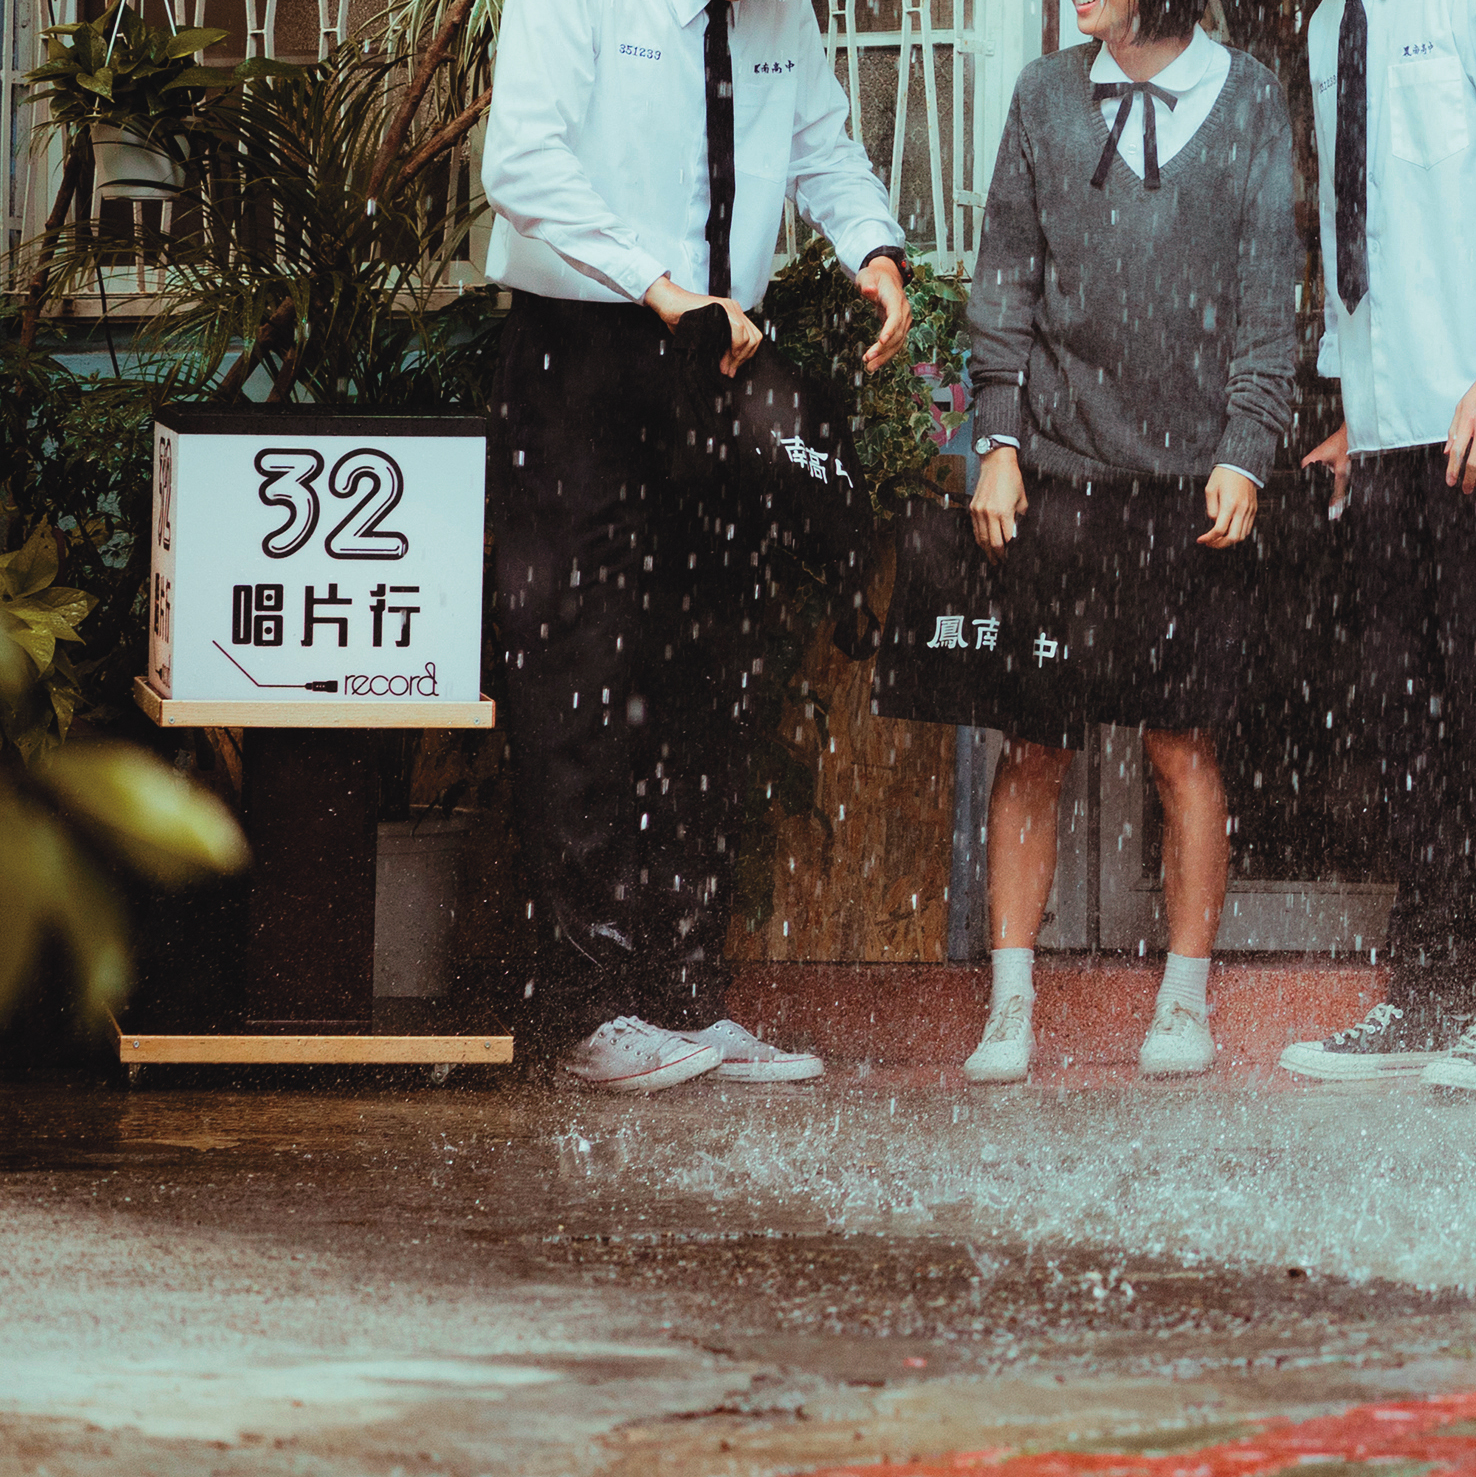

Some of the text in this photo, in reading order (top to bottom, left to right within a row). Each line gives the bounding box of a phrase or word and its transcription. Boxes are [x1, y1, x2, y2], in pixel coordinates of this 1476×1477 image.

[253, 447, 409, 561] 32
[231, 582, 421, 648] 唱片行
[927, 615, 1059, 669] 鳳南中
[344, 661, 439, 697] record
